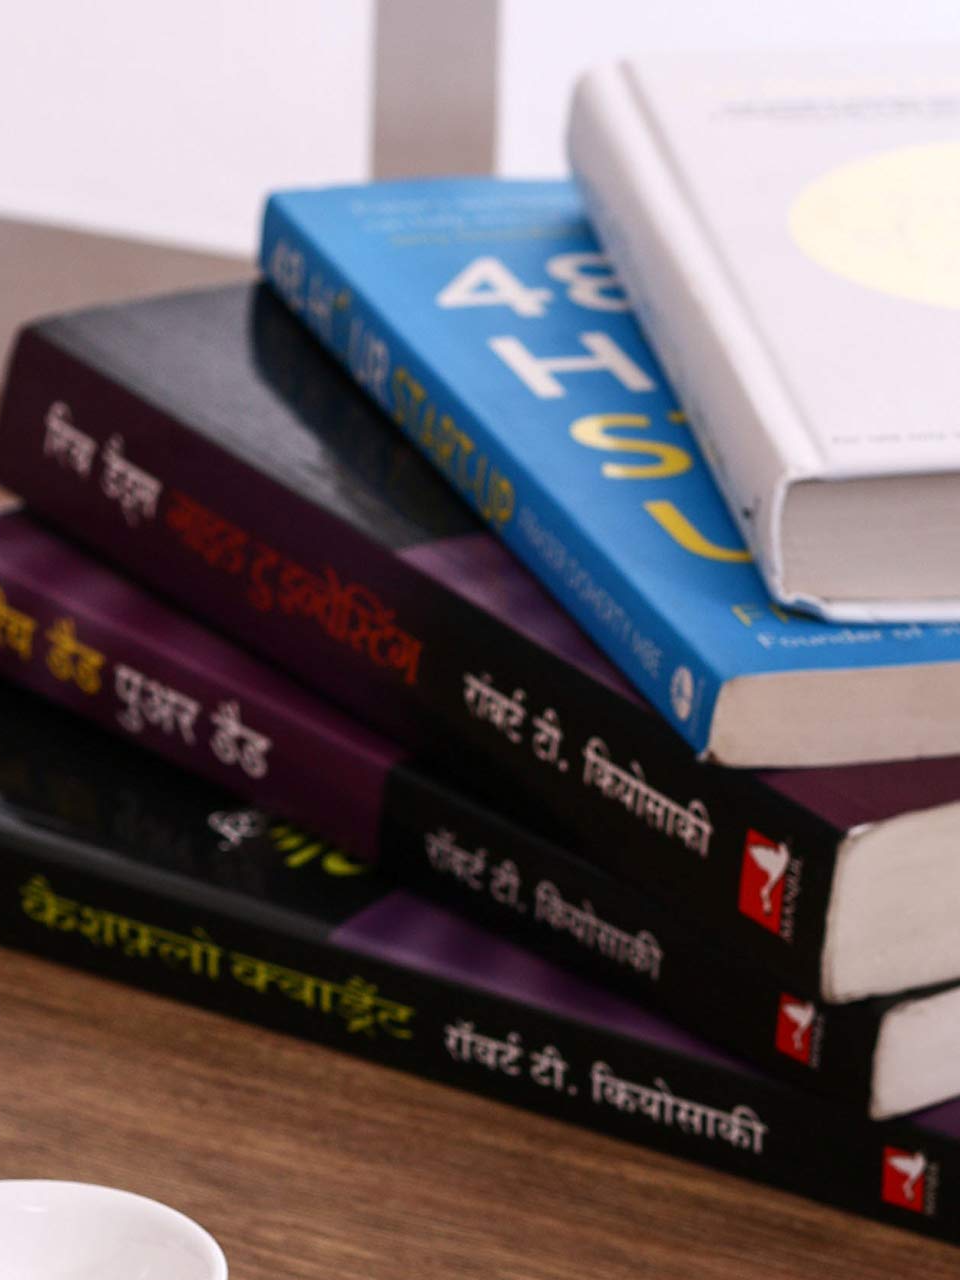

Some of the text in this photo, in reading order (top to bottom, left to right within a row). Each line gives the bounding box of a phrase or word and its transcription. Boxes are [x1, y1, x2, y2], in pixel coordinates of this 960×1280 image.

[113, 663, 202, 746] पुअर
[210, 700, 273, 779] डैड
[532, 708, 570, 773] टी.
[582, 736, 714, 858] कियोसाकी
[535, 879, 664, 981] कियोसाकी
[529, 1044, 578, 1097] टी.
[590, 1060, 769, 1155] कियोसाकी
